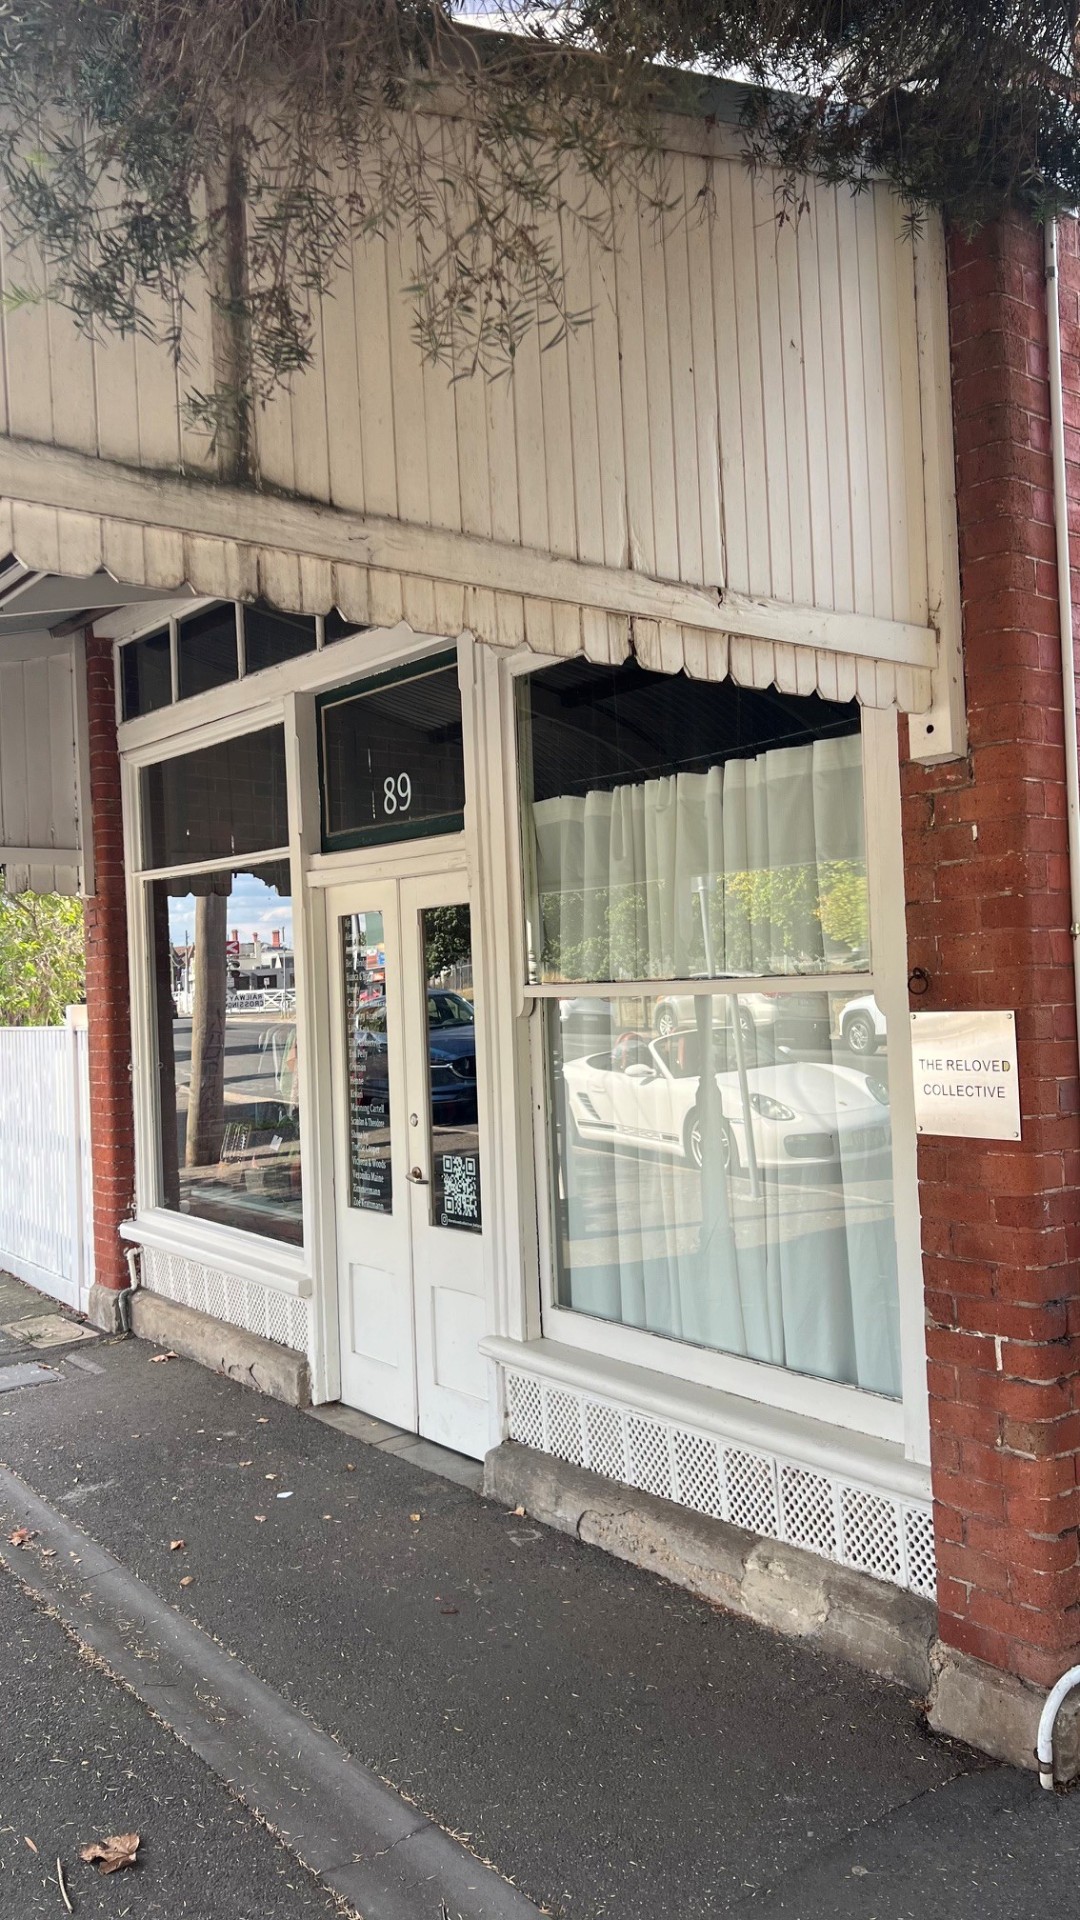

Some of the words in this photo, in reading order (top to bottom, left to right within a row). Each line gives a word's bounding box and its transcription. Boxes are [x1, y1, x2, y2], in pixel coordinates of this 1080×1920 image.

[383, 772, 412, 815] 89
[919, 1059, 943, 1071] THE
[946, 1059, 1011, 1072] RELOVED
[923, 1083, 1006, 1098] COLLECTIVE
[350, 1102, 370, 1115] Manning
[370, 1103, 385, 1113] Cartell
[371, 1159, 387, 1169] Woods
